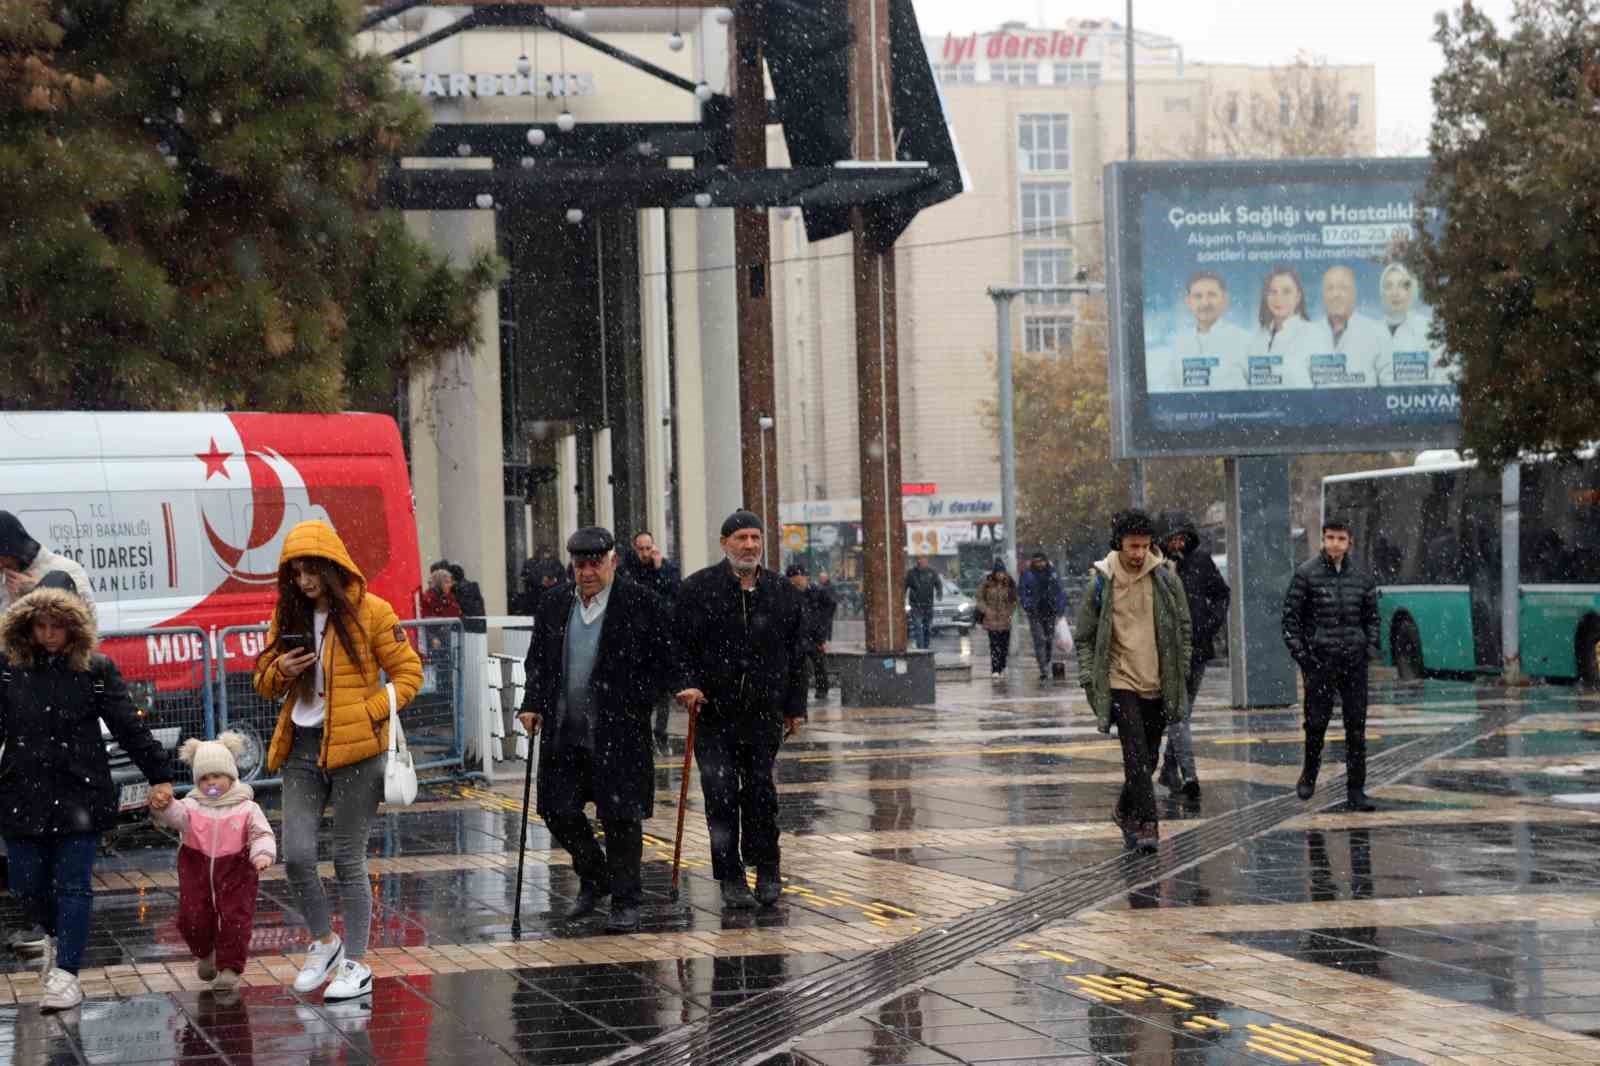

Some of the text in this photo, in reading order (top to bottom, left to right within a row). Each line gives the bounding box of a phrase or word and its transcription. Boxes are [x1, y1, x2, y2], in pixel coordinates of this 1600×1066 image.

[986, 31, 1088, 60] dersler
[1168, 207, 1232, 231] Çocuk
[1236, 206, 1300, 228] Sağlığı
[1304, 208, 1327, 222] ve
[96, 518, 151, 538] BAKANLIĞI
[90, 541, 153, 569] İDARESİ
